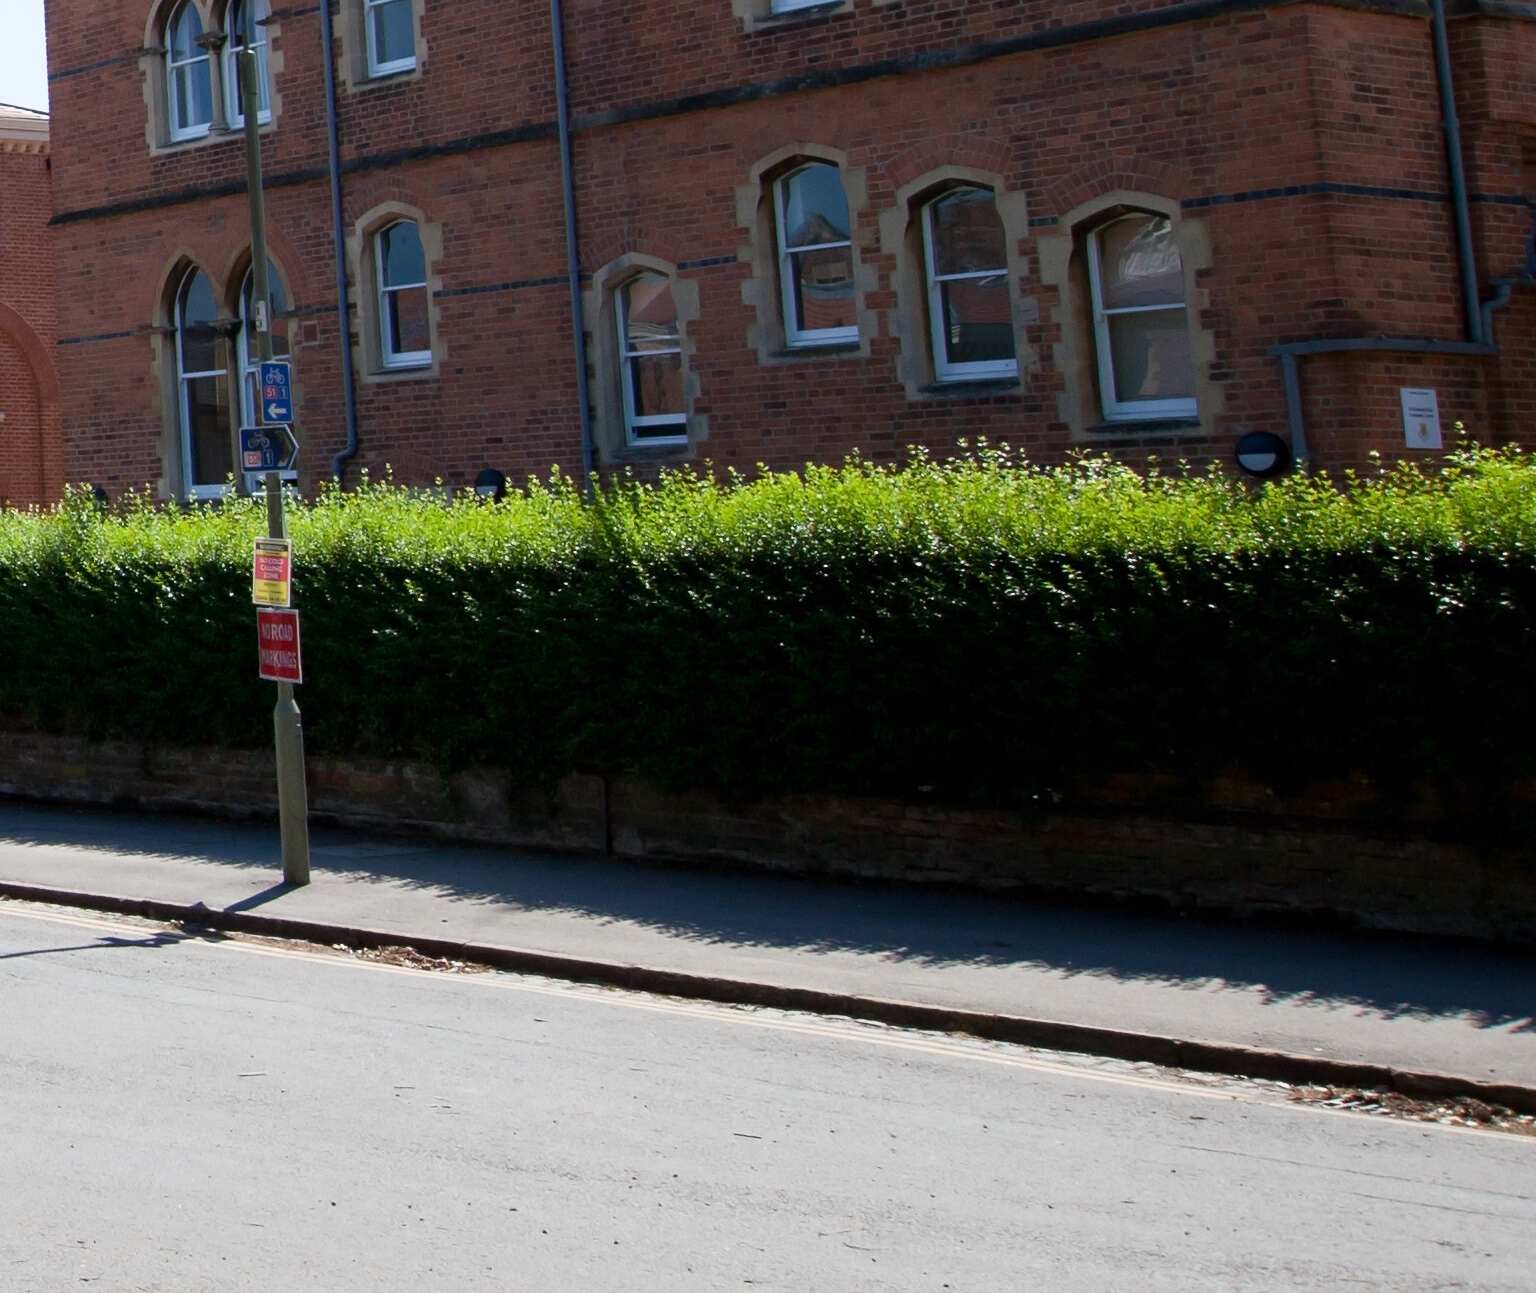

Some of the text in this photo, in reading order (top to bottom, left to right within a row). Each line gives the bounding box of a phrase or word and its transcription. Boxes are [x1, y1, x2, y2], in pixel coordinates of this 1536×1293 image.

[266, 387, 276, 397] 51
[261, 622, 294, 641] NO ROAD
[261, 649, 297, 669] MARKINGS
